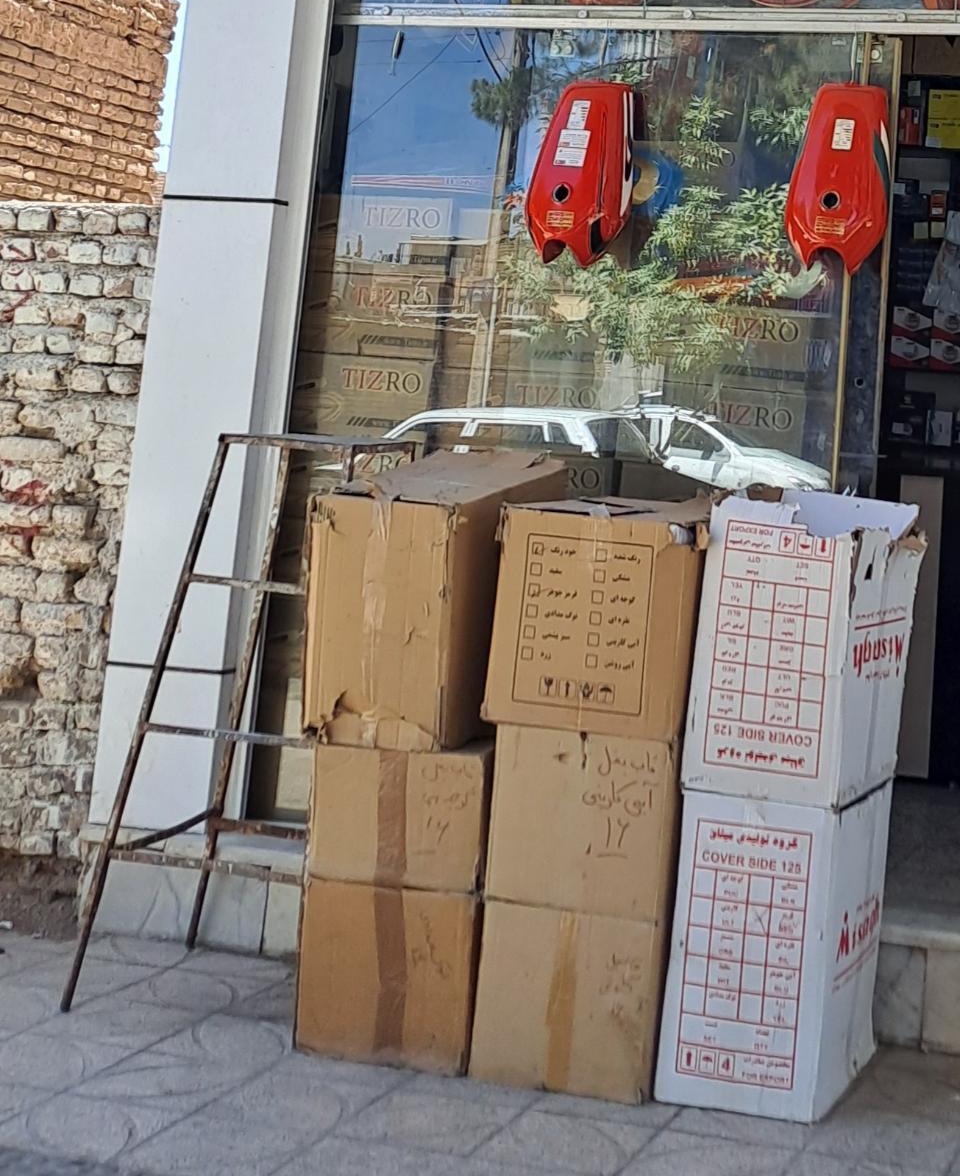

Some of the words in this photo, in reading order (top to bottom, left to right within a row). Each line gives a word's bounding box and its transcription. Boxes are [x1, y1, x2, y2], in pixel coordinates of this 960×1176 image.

[364, 206, 441, 229] TIZRO
[342, 367, 421, 394] TIZRO
[516, 384, 598, 409] TIZRO
[730, 525, 757, 534] EXPORT
[759, 528, 774, 536] FOR
[727, 609, 741, 617] BLU
[713, 723, 733, 737] 125
[737, 726, 765, 742] SIDE
[768, 731, 812, 748] COVER
[702, 850, 745, 868] COVER
[748, 859, 777, 871] SIDE
[782, 862, 802, 874] 125
